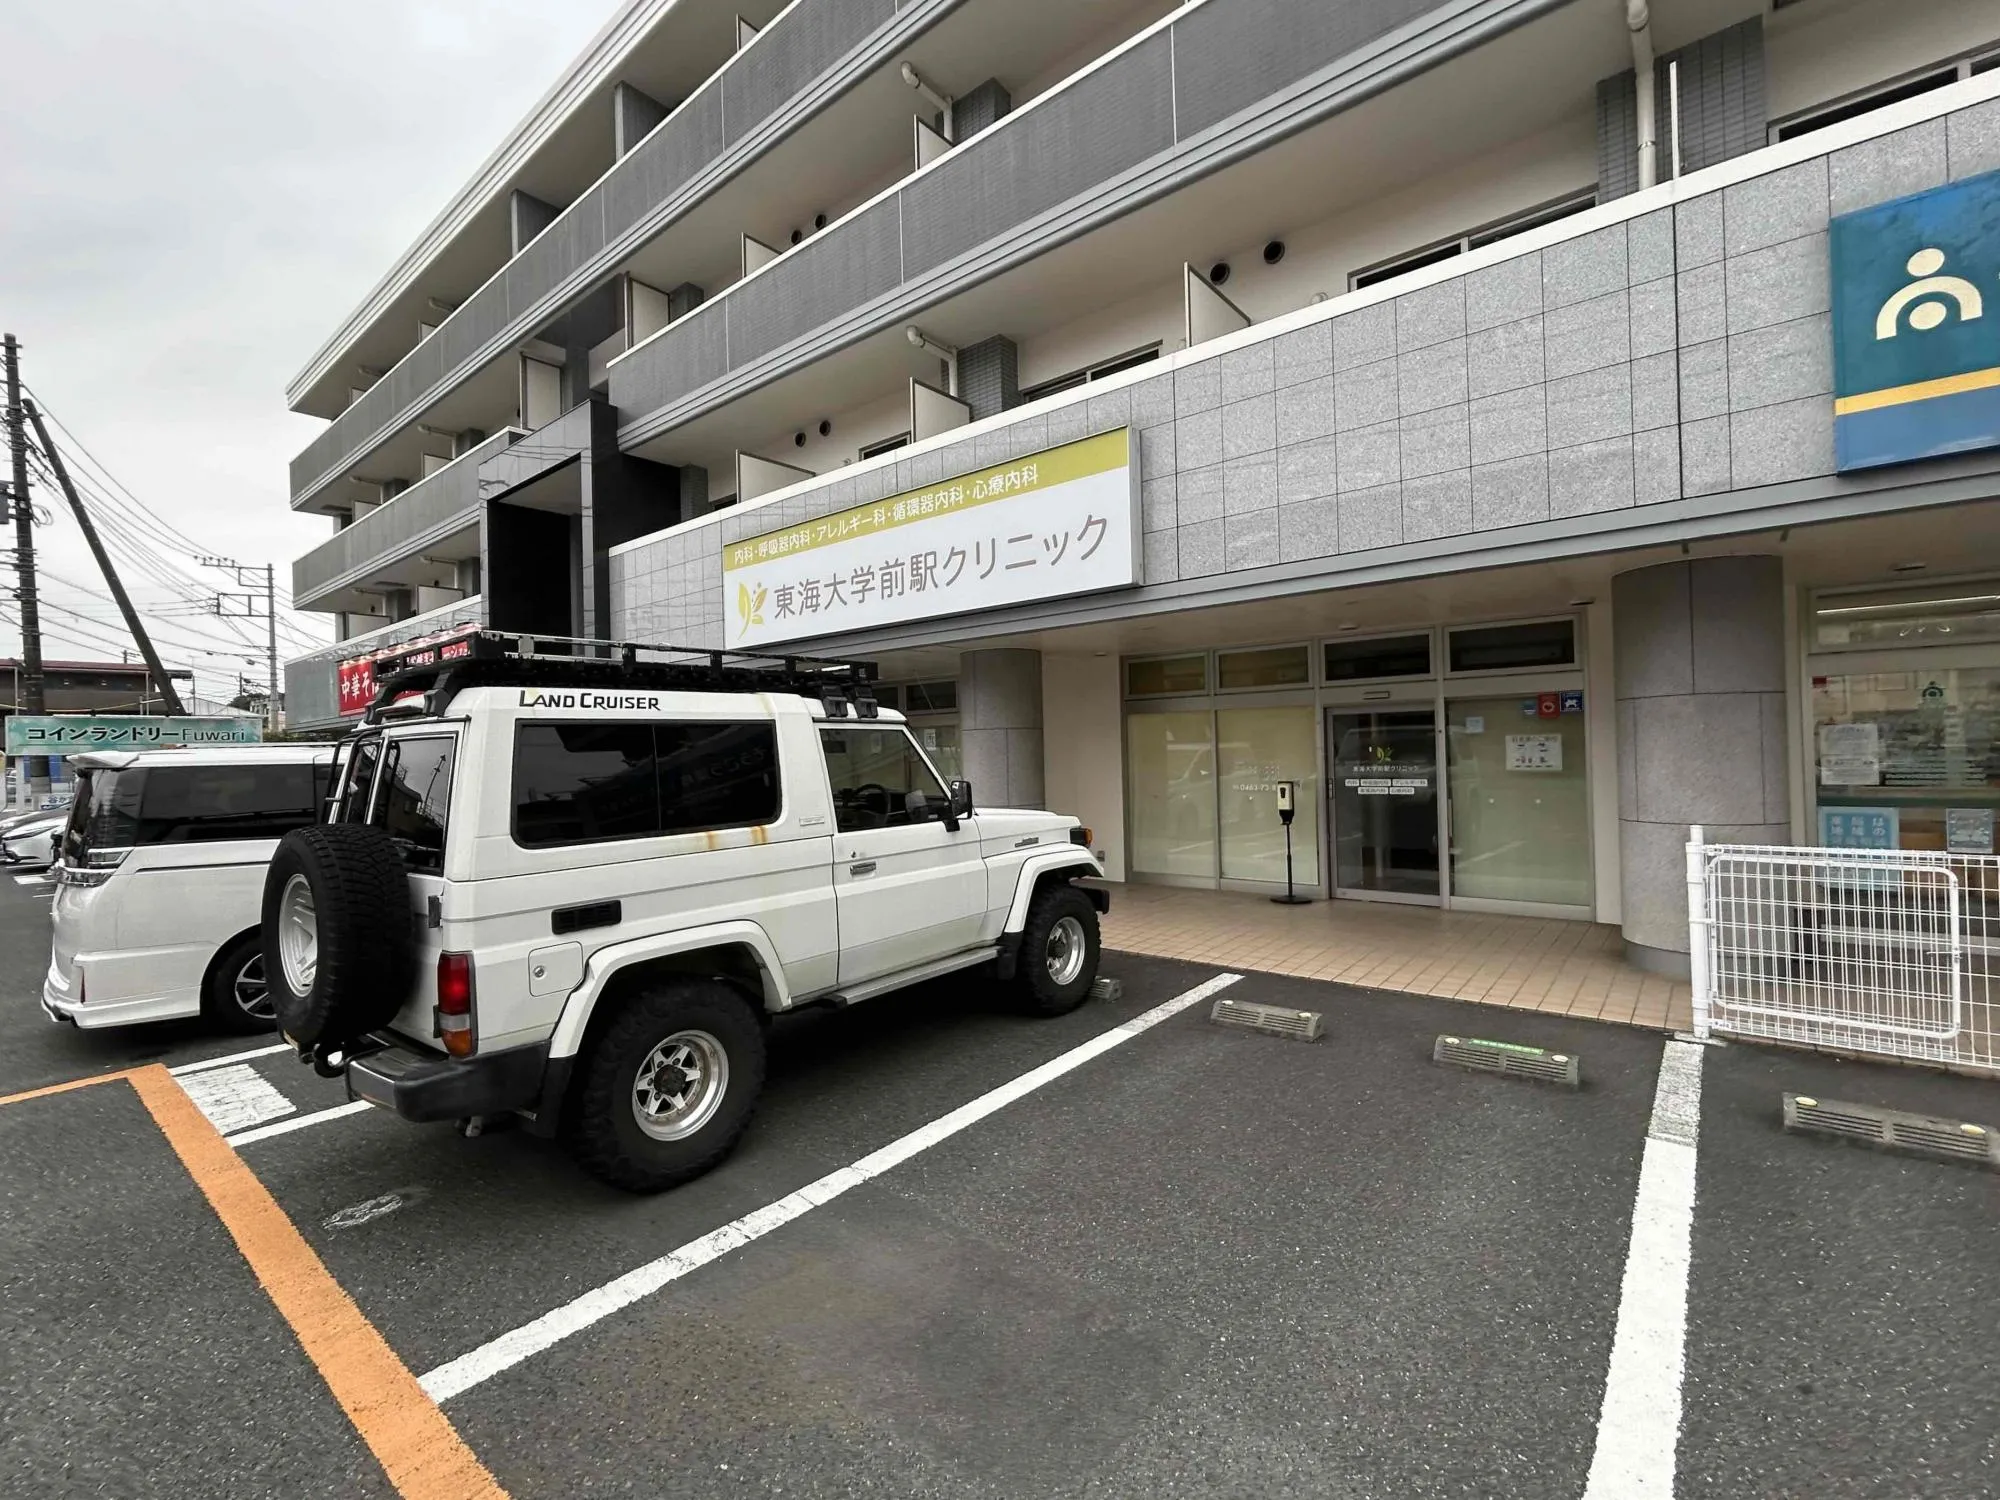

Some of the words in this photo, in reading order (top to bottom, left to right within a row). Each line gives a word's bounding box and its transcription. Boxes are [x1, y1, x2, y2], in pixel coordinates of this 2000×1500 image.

[773, 514, 1108, 619] 東海大学前駅クリニック
[519, 690, 575, 707] LAND
[580, 693, 661, 711] CRUISER
[28, 727, 180, 742] コインランドリー
[182, 728, 245, 741] Fuwari
